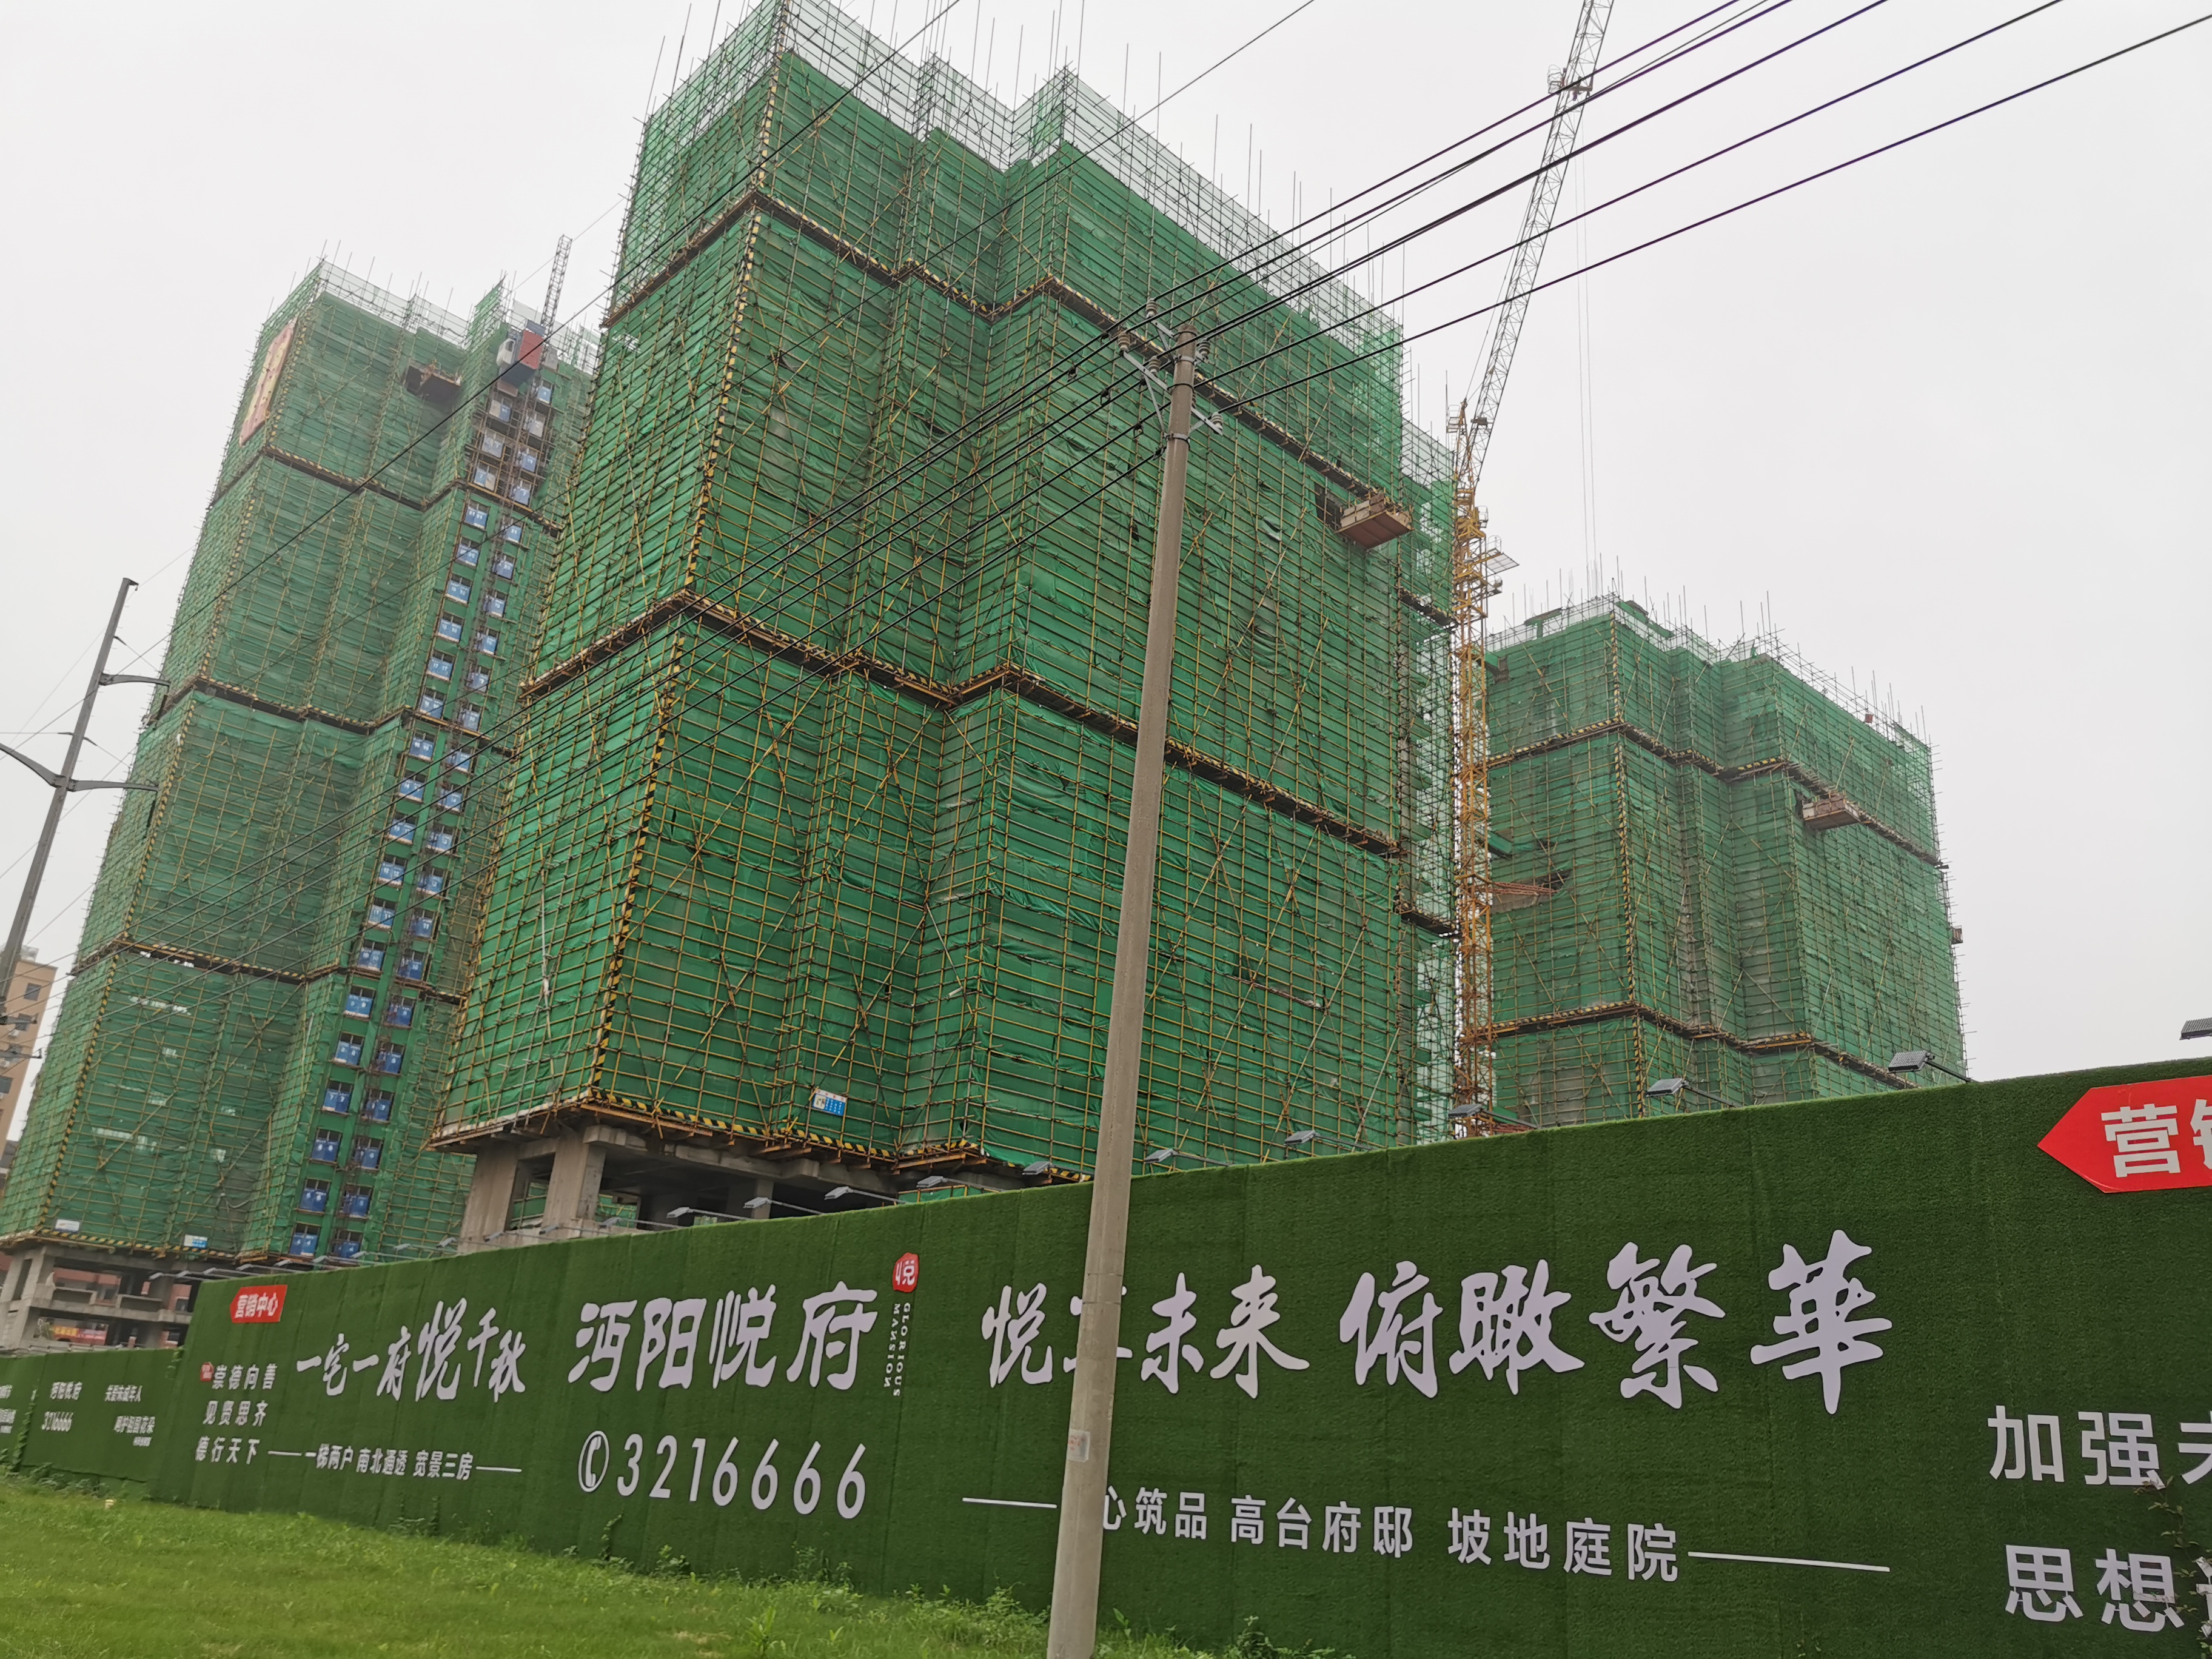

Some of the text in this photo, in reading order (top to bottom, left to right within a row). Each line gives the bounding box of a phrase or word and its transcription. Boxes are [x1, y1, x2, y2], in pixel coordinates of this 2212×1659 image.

[235, 1292, 278, 1318] 营销中心
[568, 1281, 877, 1392] 沔阳悦府
[883, 1304, 900, 1387] MANSION
[982, 1265, 1310, 1399] 悦未来
[212, 1363, 278, 1390] 崇德向善
[893, 1302, 911, 1396] GLORIOUS
[203, 1400, 268, 1426] 见贤思齐
[305, 1443, 474, 1480] 一梯两户 南北通透 宽景三房
[617, 1433, 866, 1519] 3216666
[1102, 1486, 1678, 1582] 心筑品 高台府邸 坡地庭院
[2005, 1544, 2212, 1637] 思想
